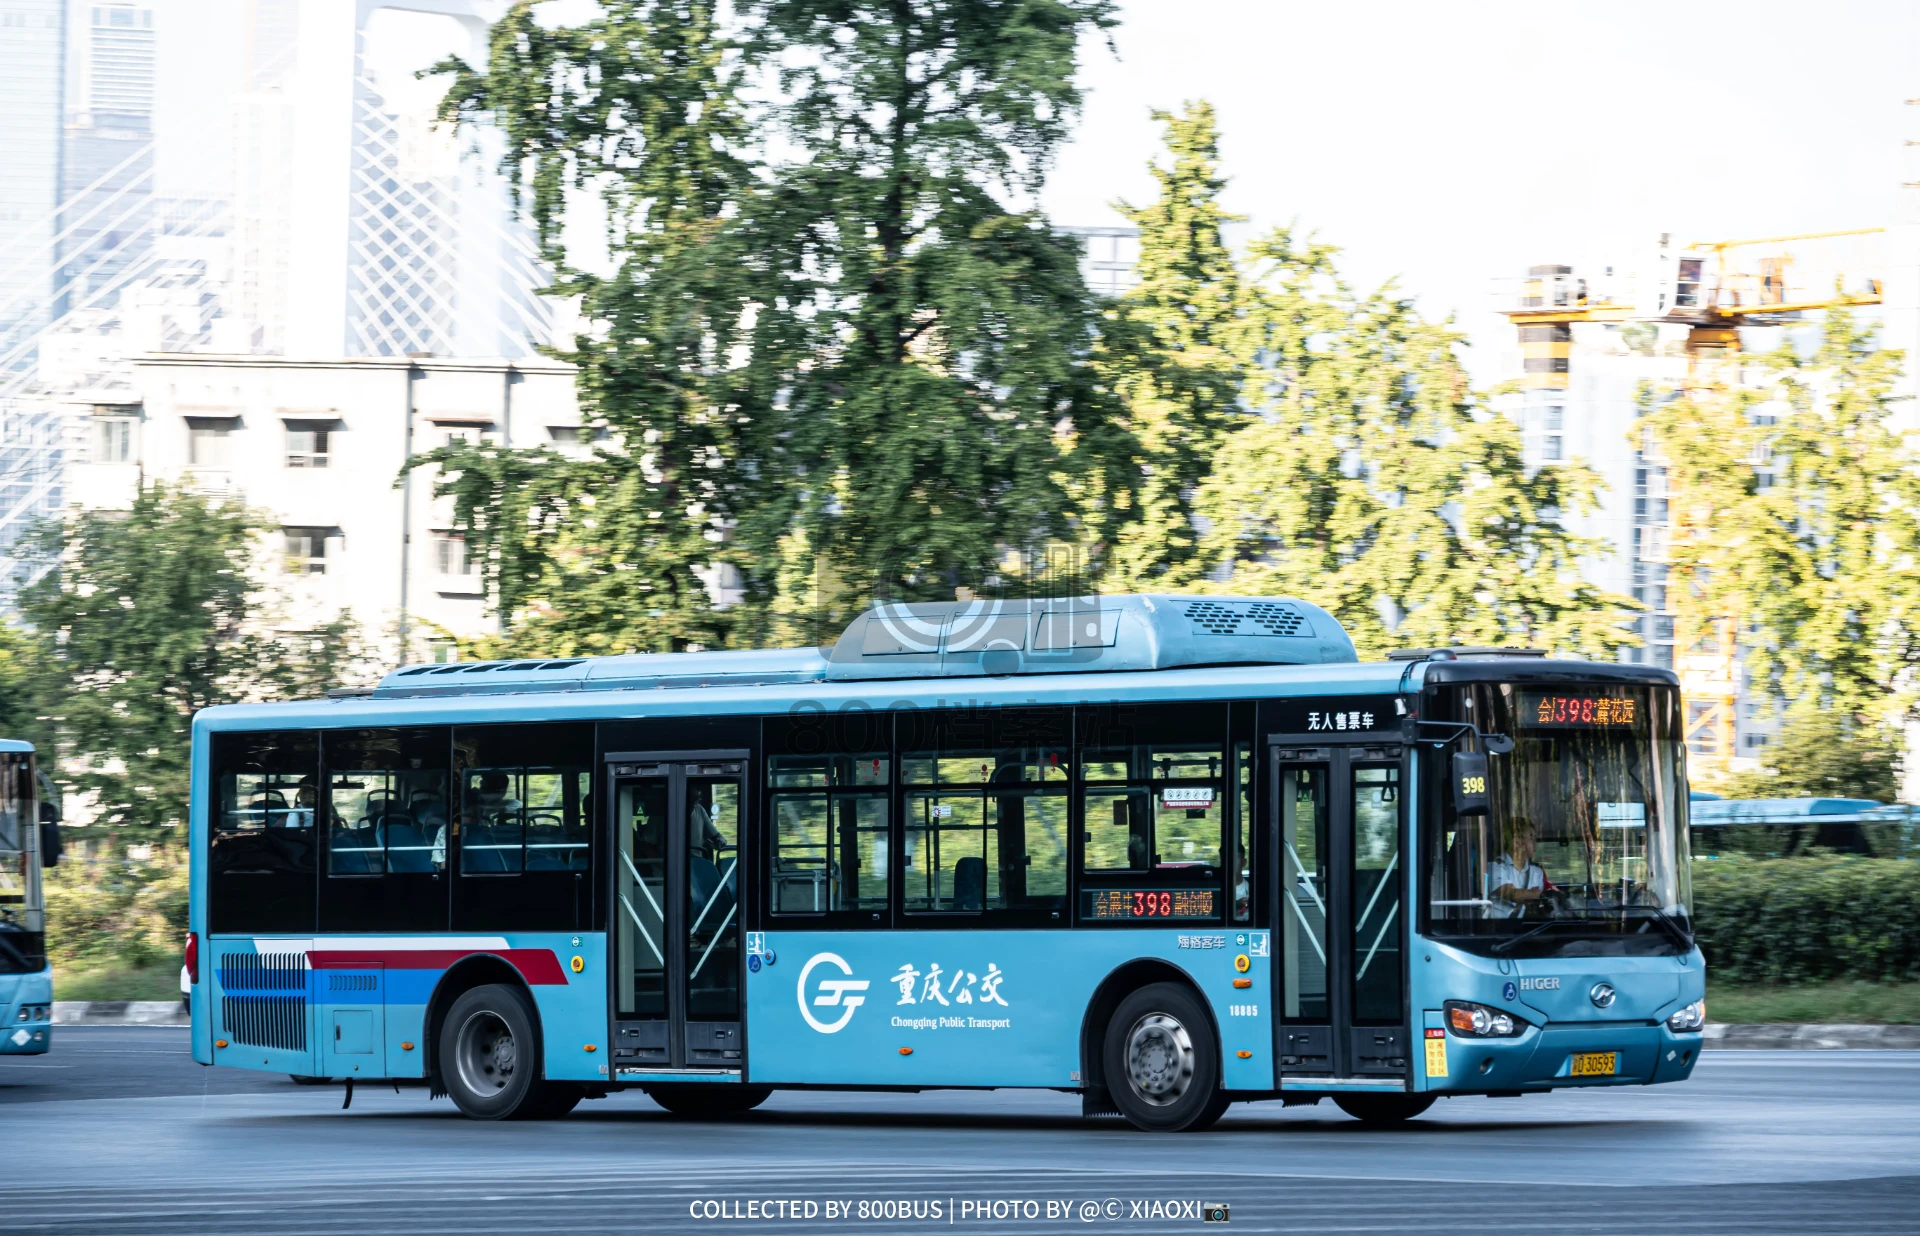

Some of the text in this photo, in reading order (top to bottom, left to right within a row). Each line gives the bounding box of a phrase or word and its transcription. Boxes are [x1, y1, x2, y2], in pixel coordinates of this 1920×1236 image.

[1555, 698, 1593, 722] 398
[1308, 711, 1375, 731] 无人售票车
[1462, 776, 1486, 794] 398
[1133, 892, 1172, 916] 398
[1178, 935, 1226, 949] 海格客车
[890, 963, 1009, 1007] 重庆公交
[1520, 977, 1560, 991] HIGER
[1229, 1005, 1258, 1017] 18885
[891, 1016, 1011, 1030] Chongqing Public Transport
